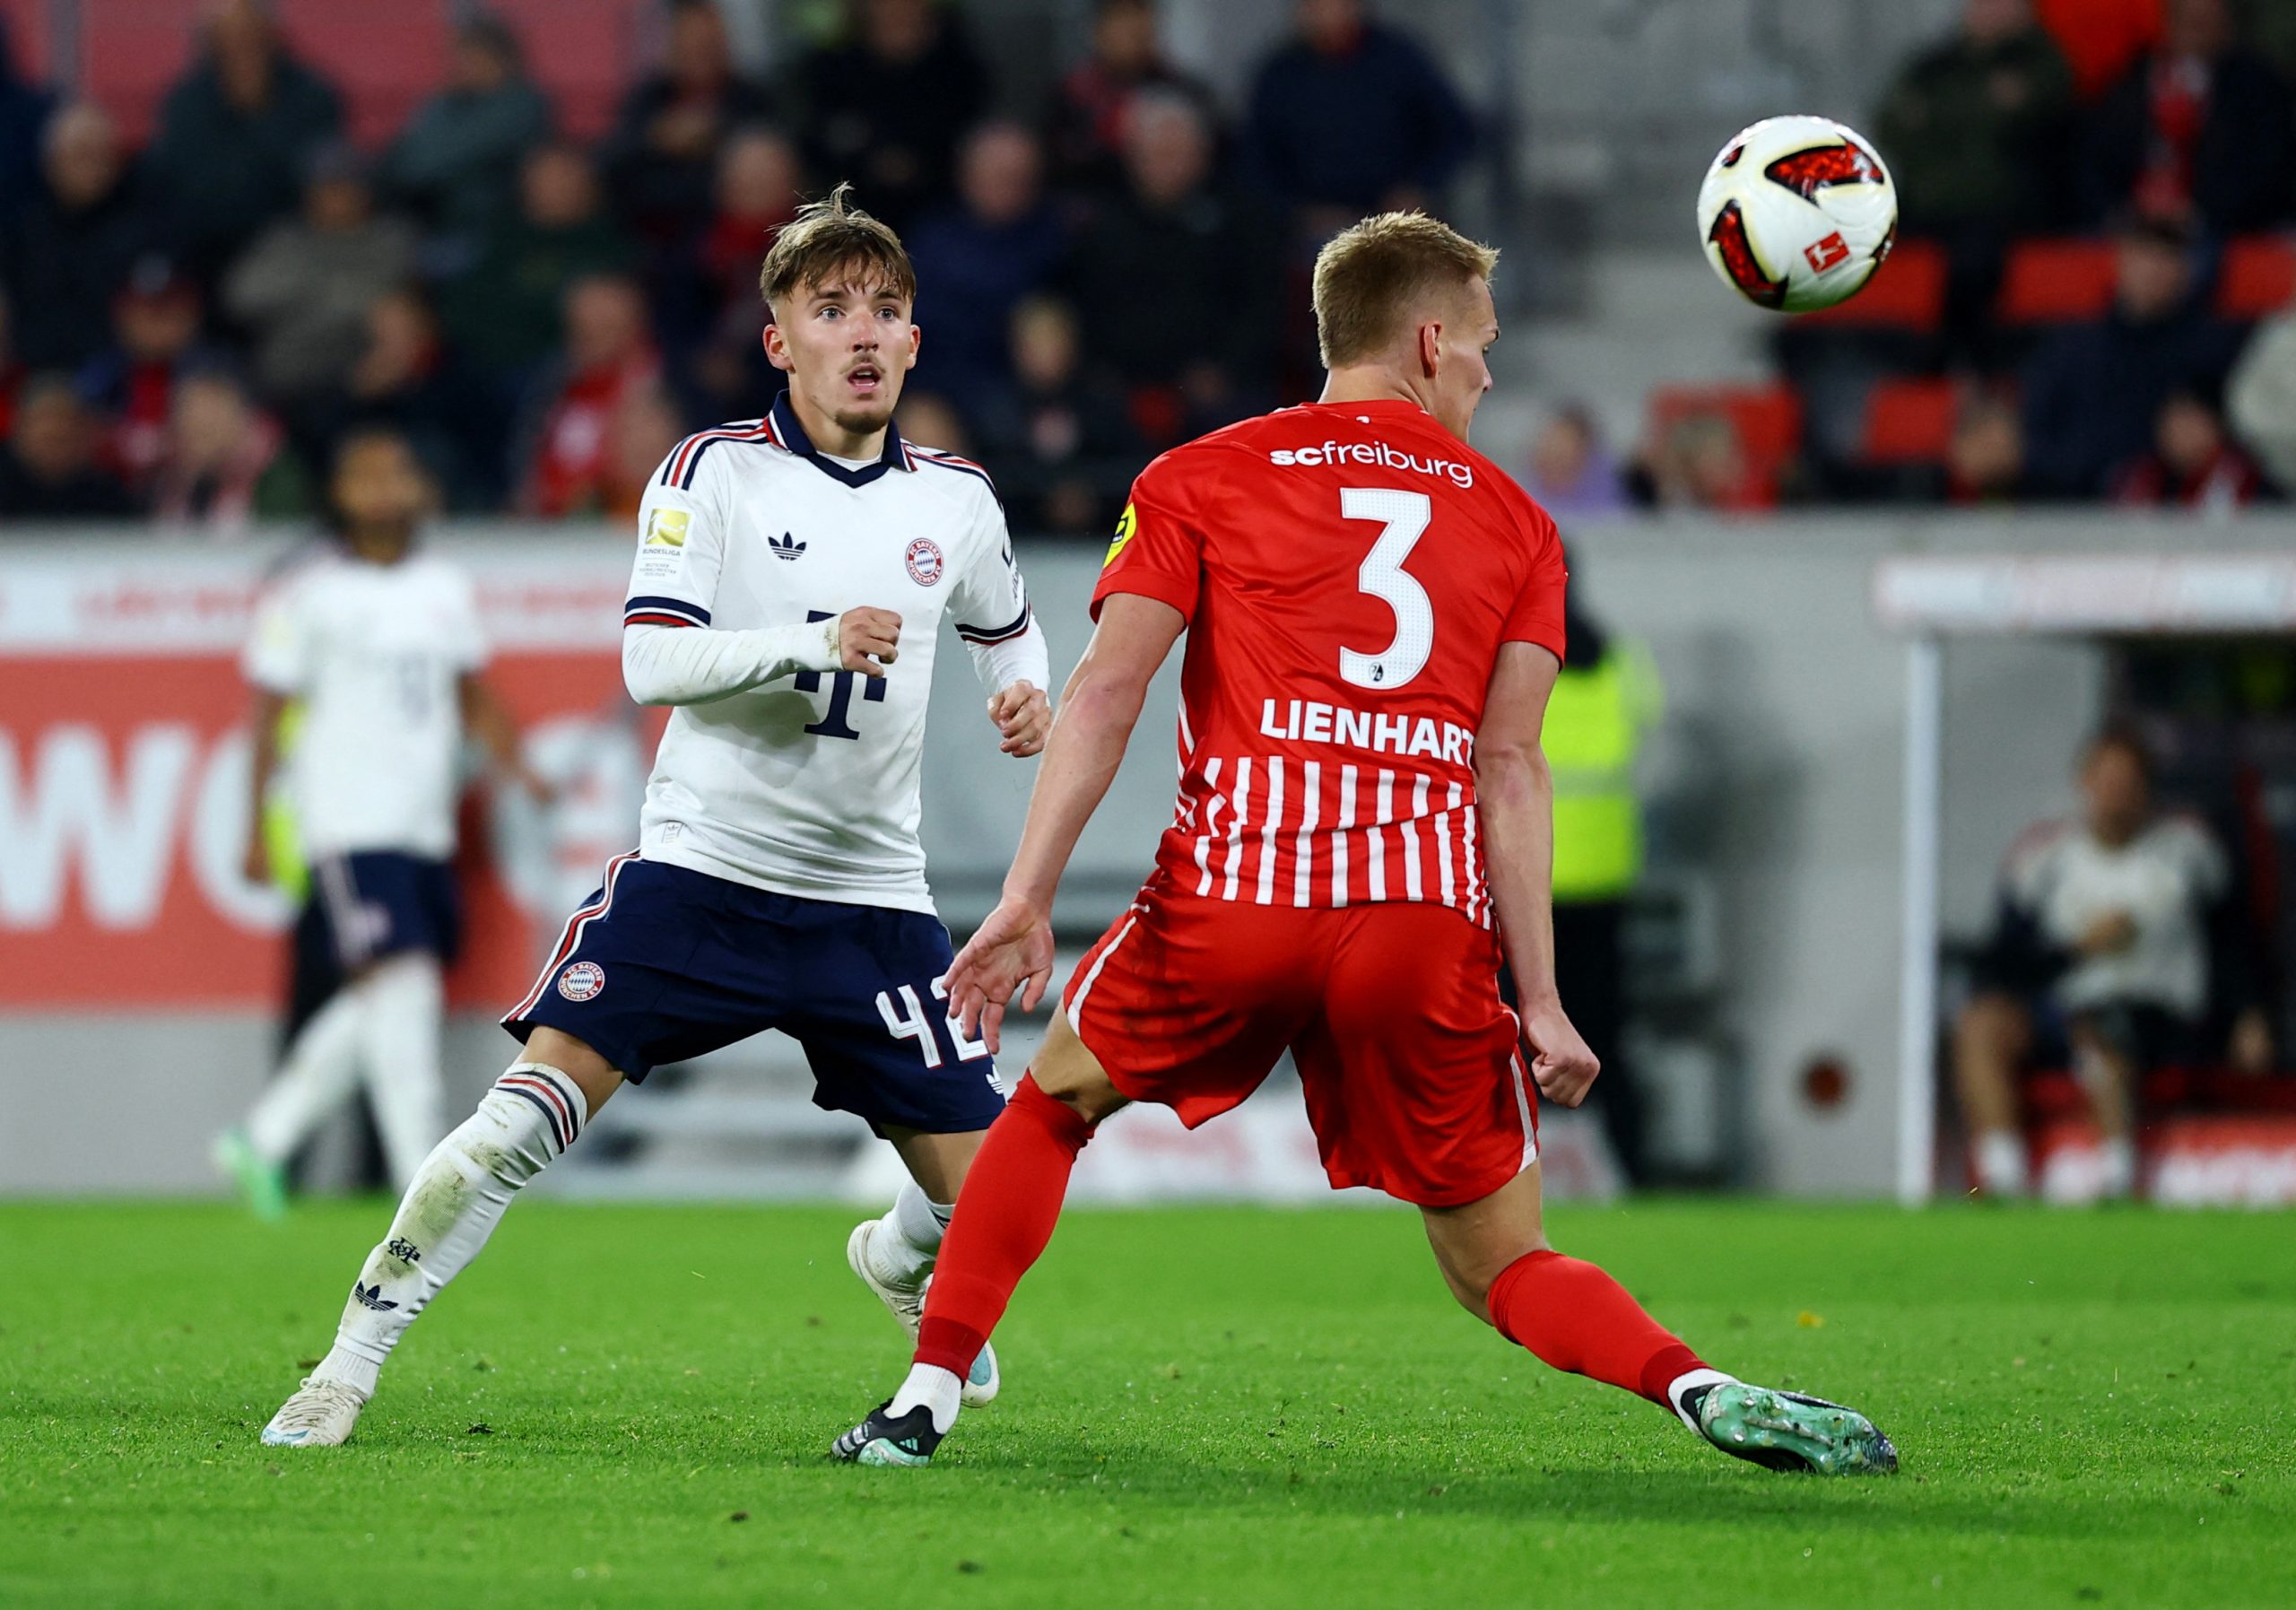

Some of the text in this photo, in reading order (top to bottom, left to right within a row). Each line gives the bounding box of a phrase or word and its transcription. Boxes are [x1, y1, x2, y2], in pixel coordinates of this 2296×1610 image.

[1270, 440, 1474, 488] scfreiburg
[916, 542, 940, 559] BAYERN
[1339, 486, 1434, 690] 3
[578, 963, 603, 981] BAYERN
